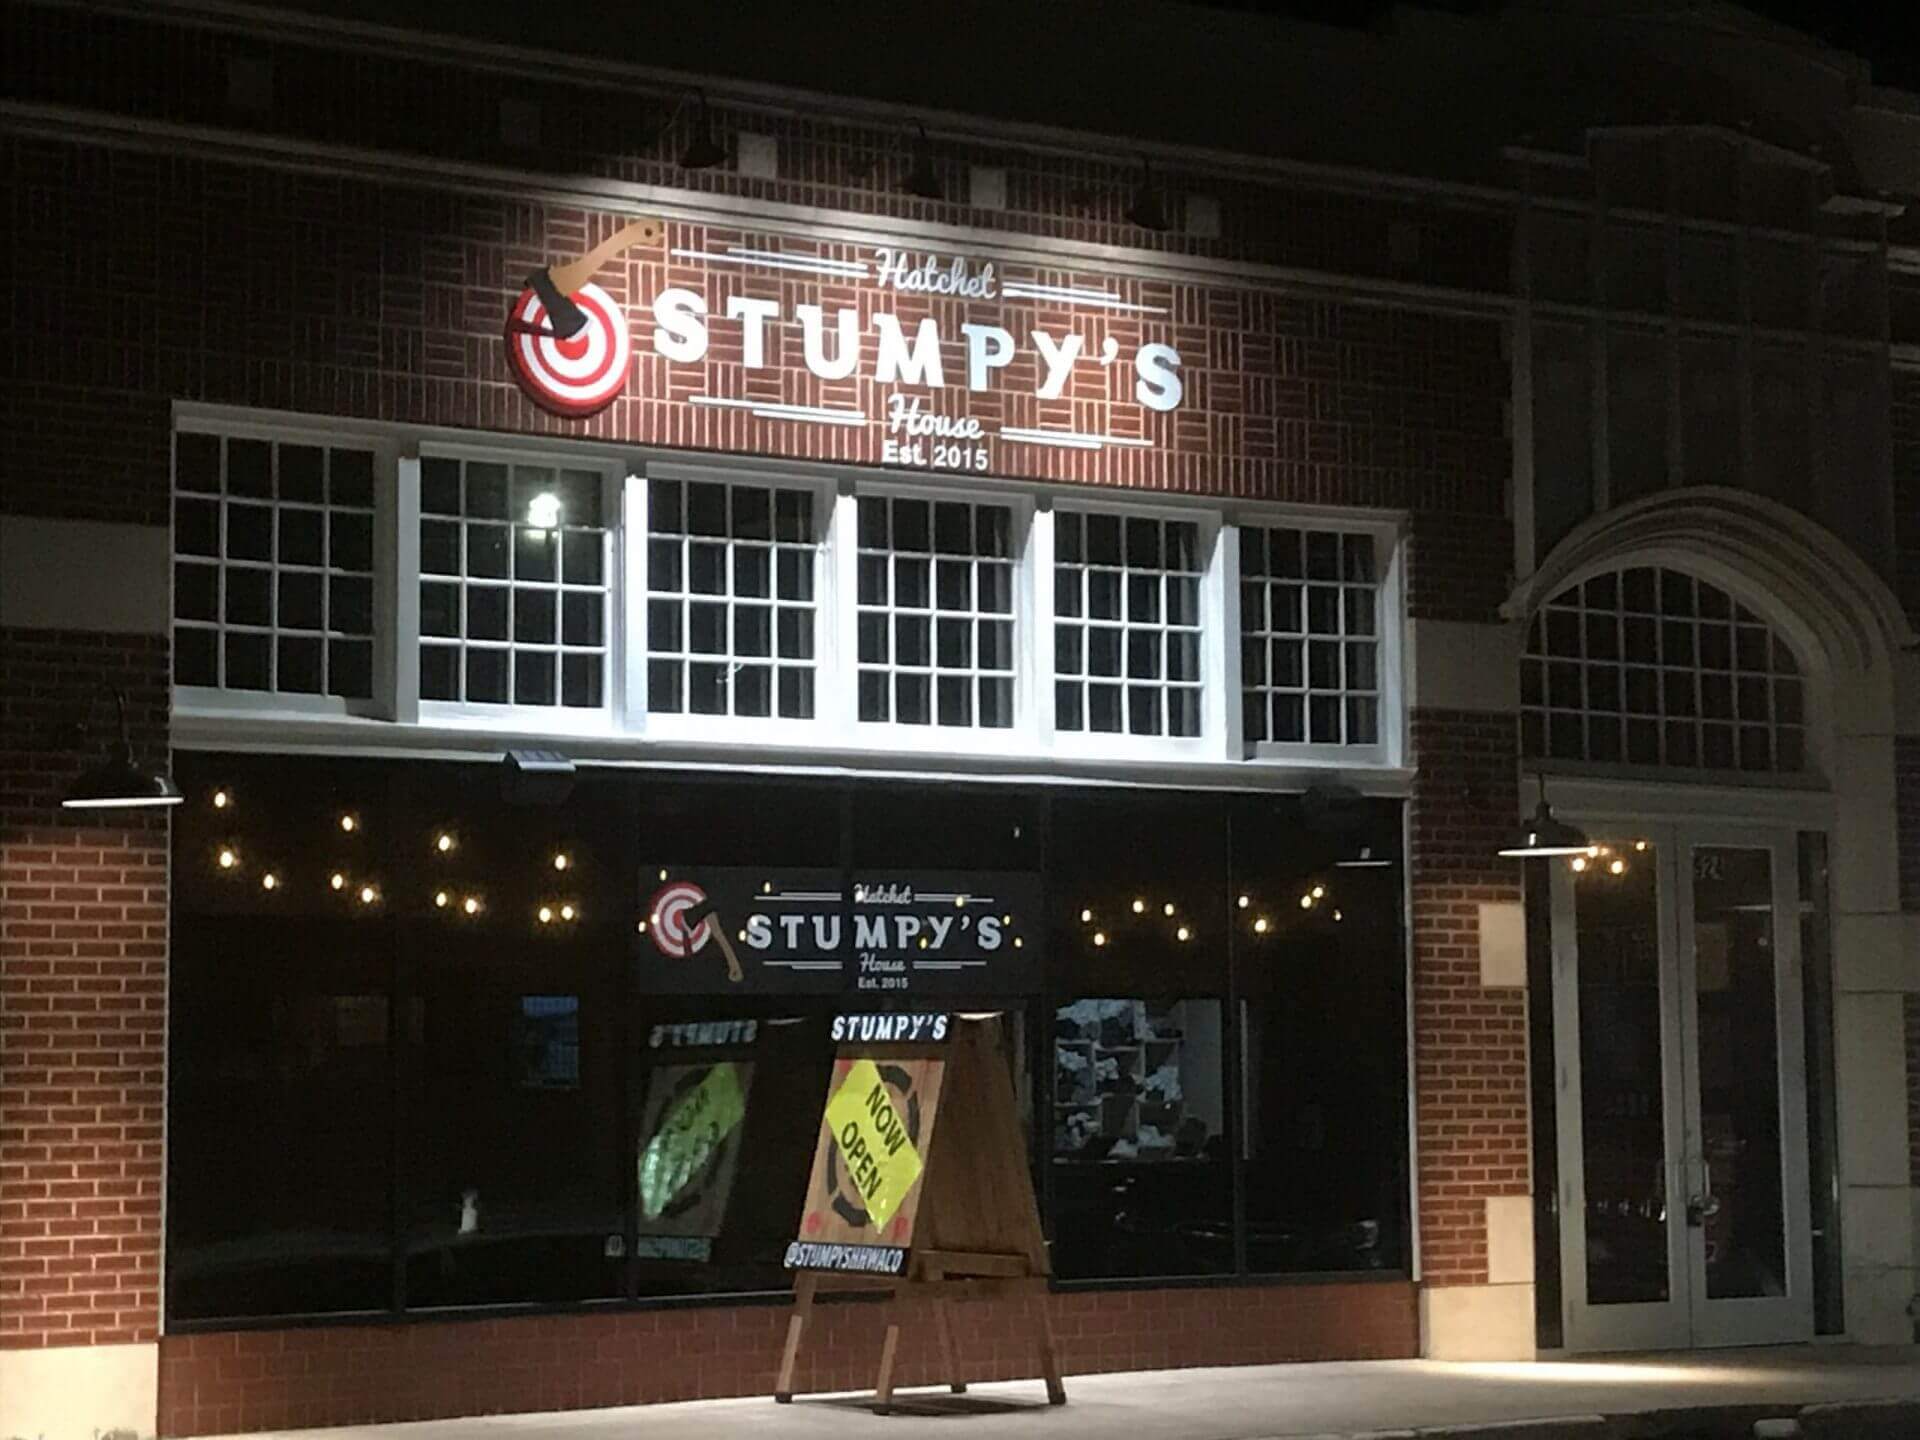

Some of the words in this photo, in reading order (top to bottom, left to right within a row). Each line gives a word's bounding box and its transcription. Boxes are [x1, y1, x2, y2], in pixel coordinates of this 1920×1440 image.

[876, 247, 997, 299] Hatchet
[652, 286, 1184, 412] STUMPY'S
[887, 393, 985, 441] House
[882, 439, 926, 466] Est.
[933, 445, 989, 471] 2015
[854, 883, 912, 905] Hatchet
[746, 914, 1002, 950] STUMPY'S
[859, 952, 907, 973] House
[858, 977, 880, 990] Est.
[881, 977, 909, 990] 2015
[830, 1014, 949, 1042] STUMPY'S
[865, 1083, 907, 1157] NOW
[841, 1121, 883, 1201] OPEN
